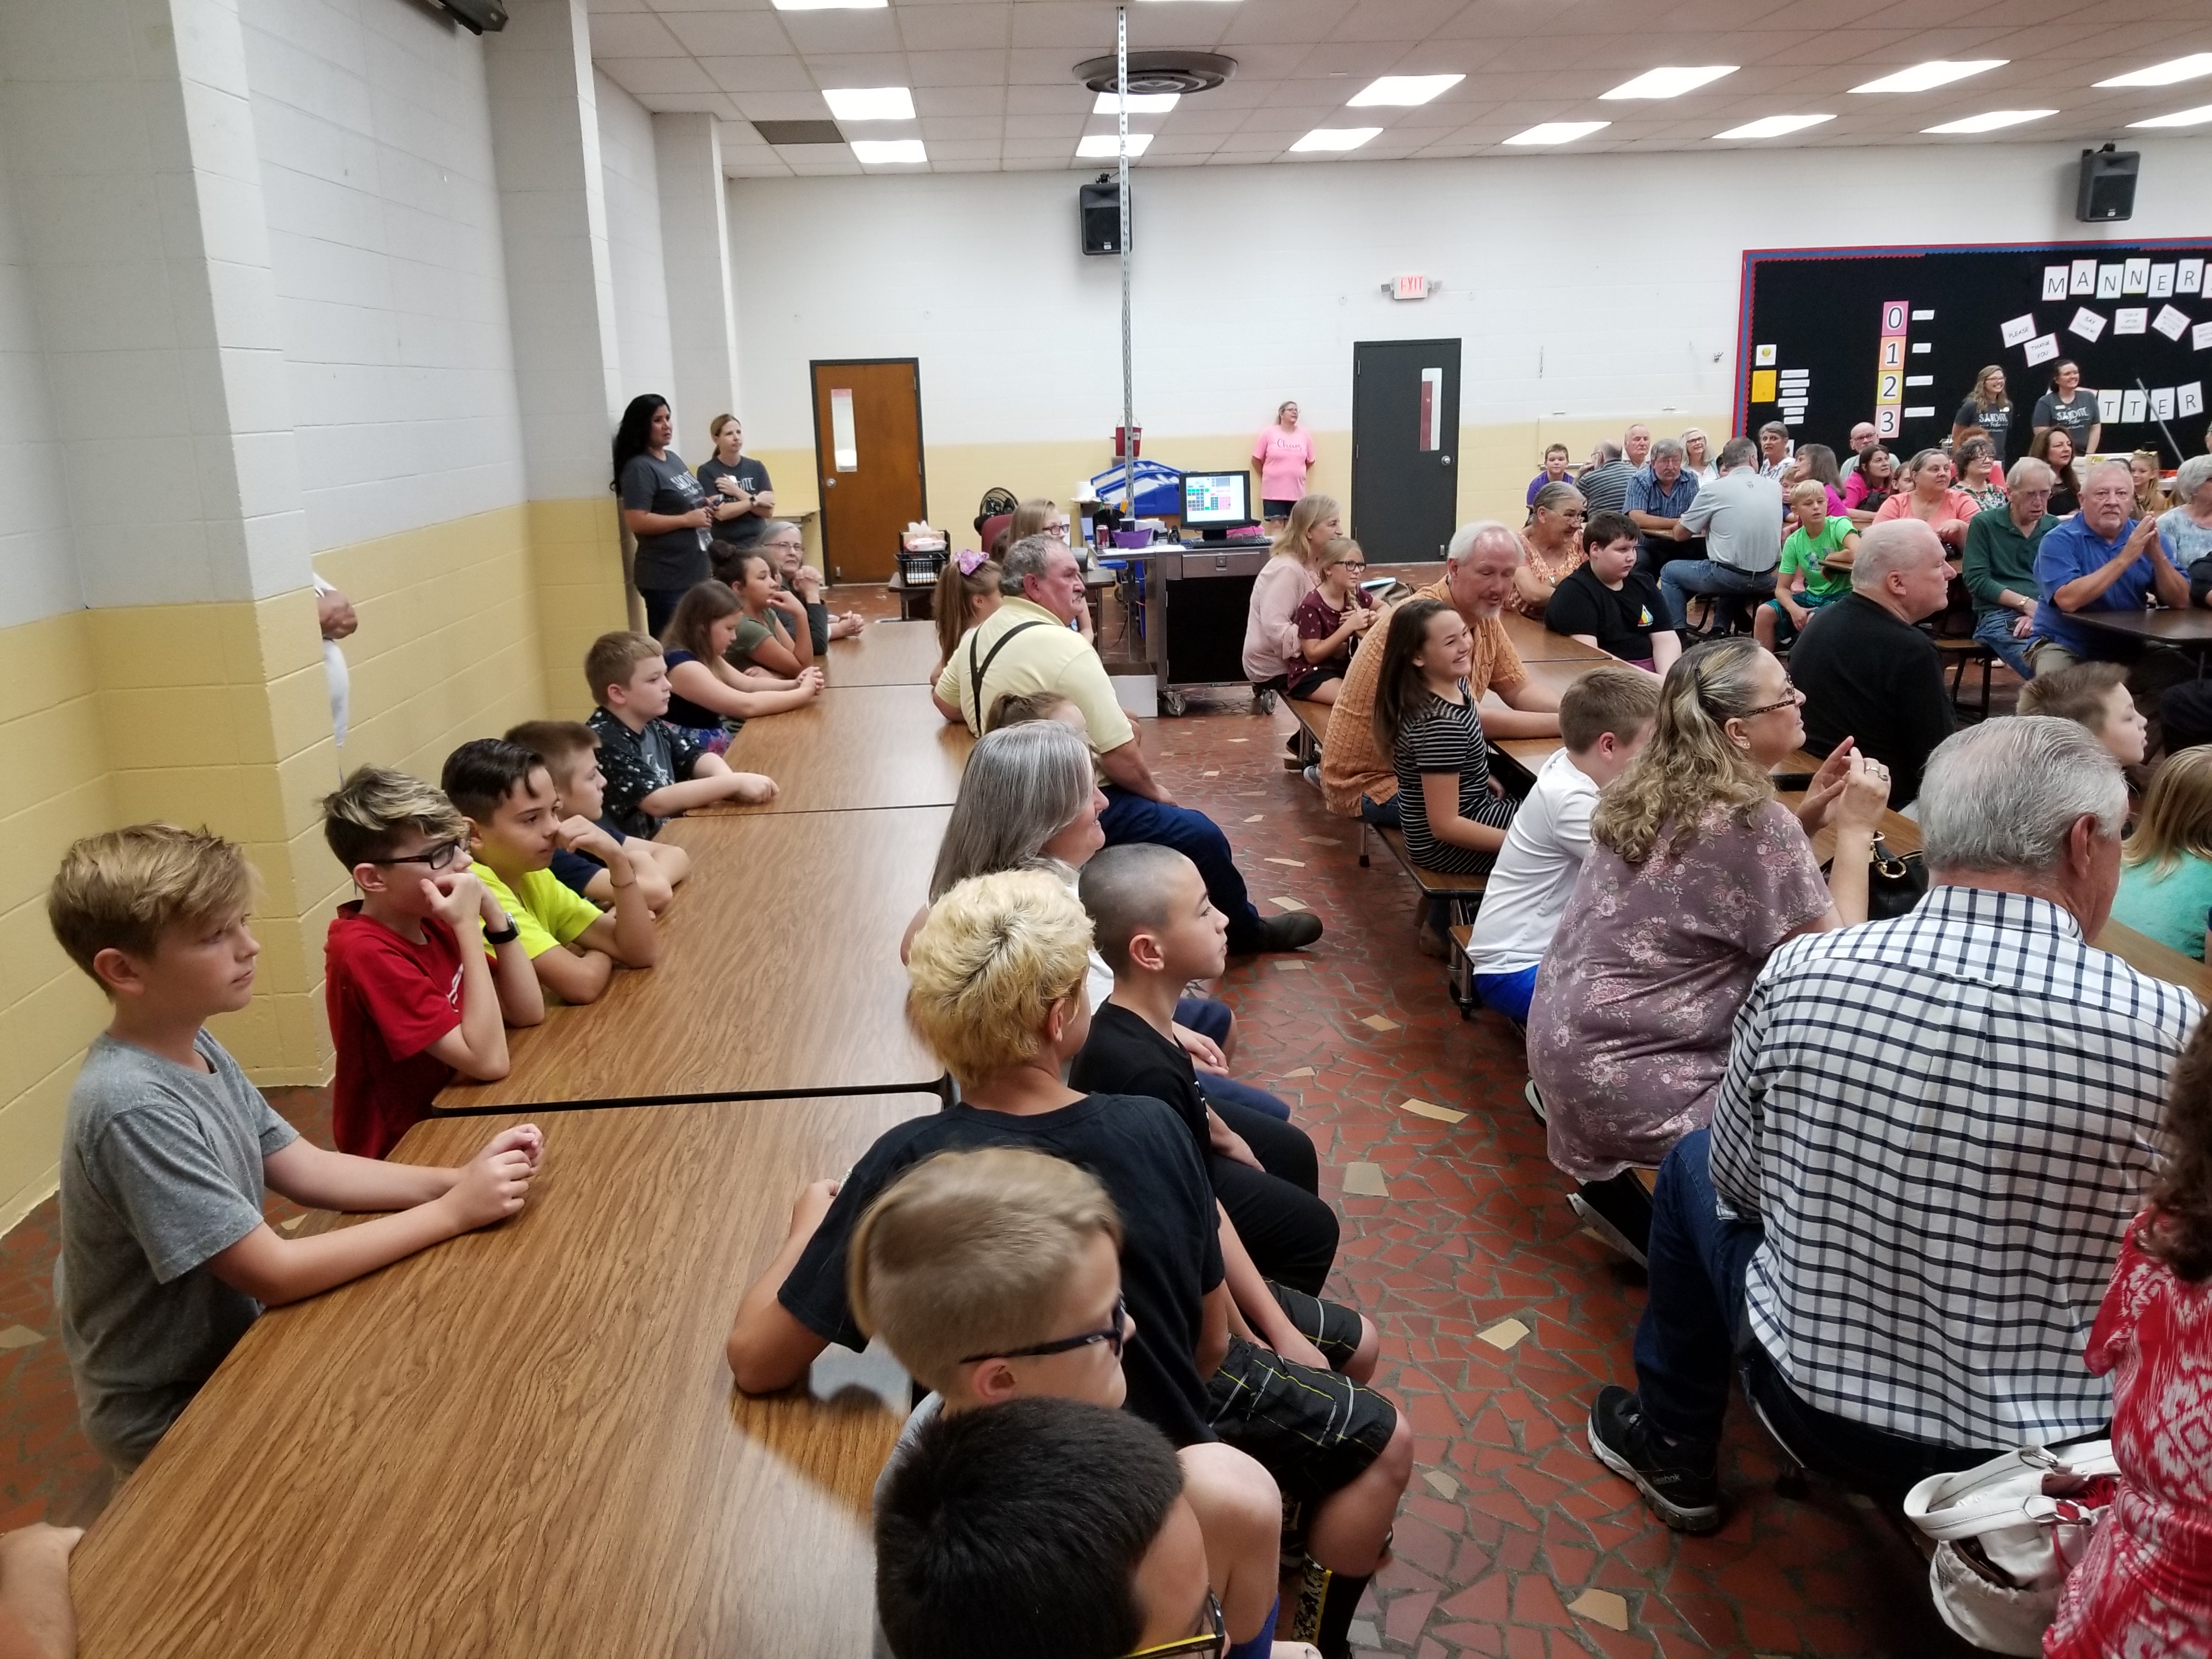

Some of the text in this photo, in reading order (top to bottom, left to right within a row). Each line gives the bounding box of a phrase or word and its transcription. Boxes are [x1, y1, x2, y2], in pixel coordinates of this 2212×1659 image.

[2047, 270, 2212, 294] MANNER
[1888, 307, 1902, 329] 0
[2008, 327, 2029, 338] PLEASE
[1886, 343, 1898, 364] 1
[2030, 340, 2051, 350] THANK
[1883, 376, 1897, 397] 2
[1881, 411, 1893, 432] 3
